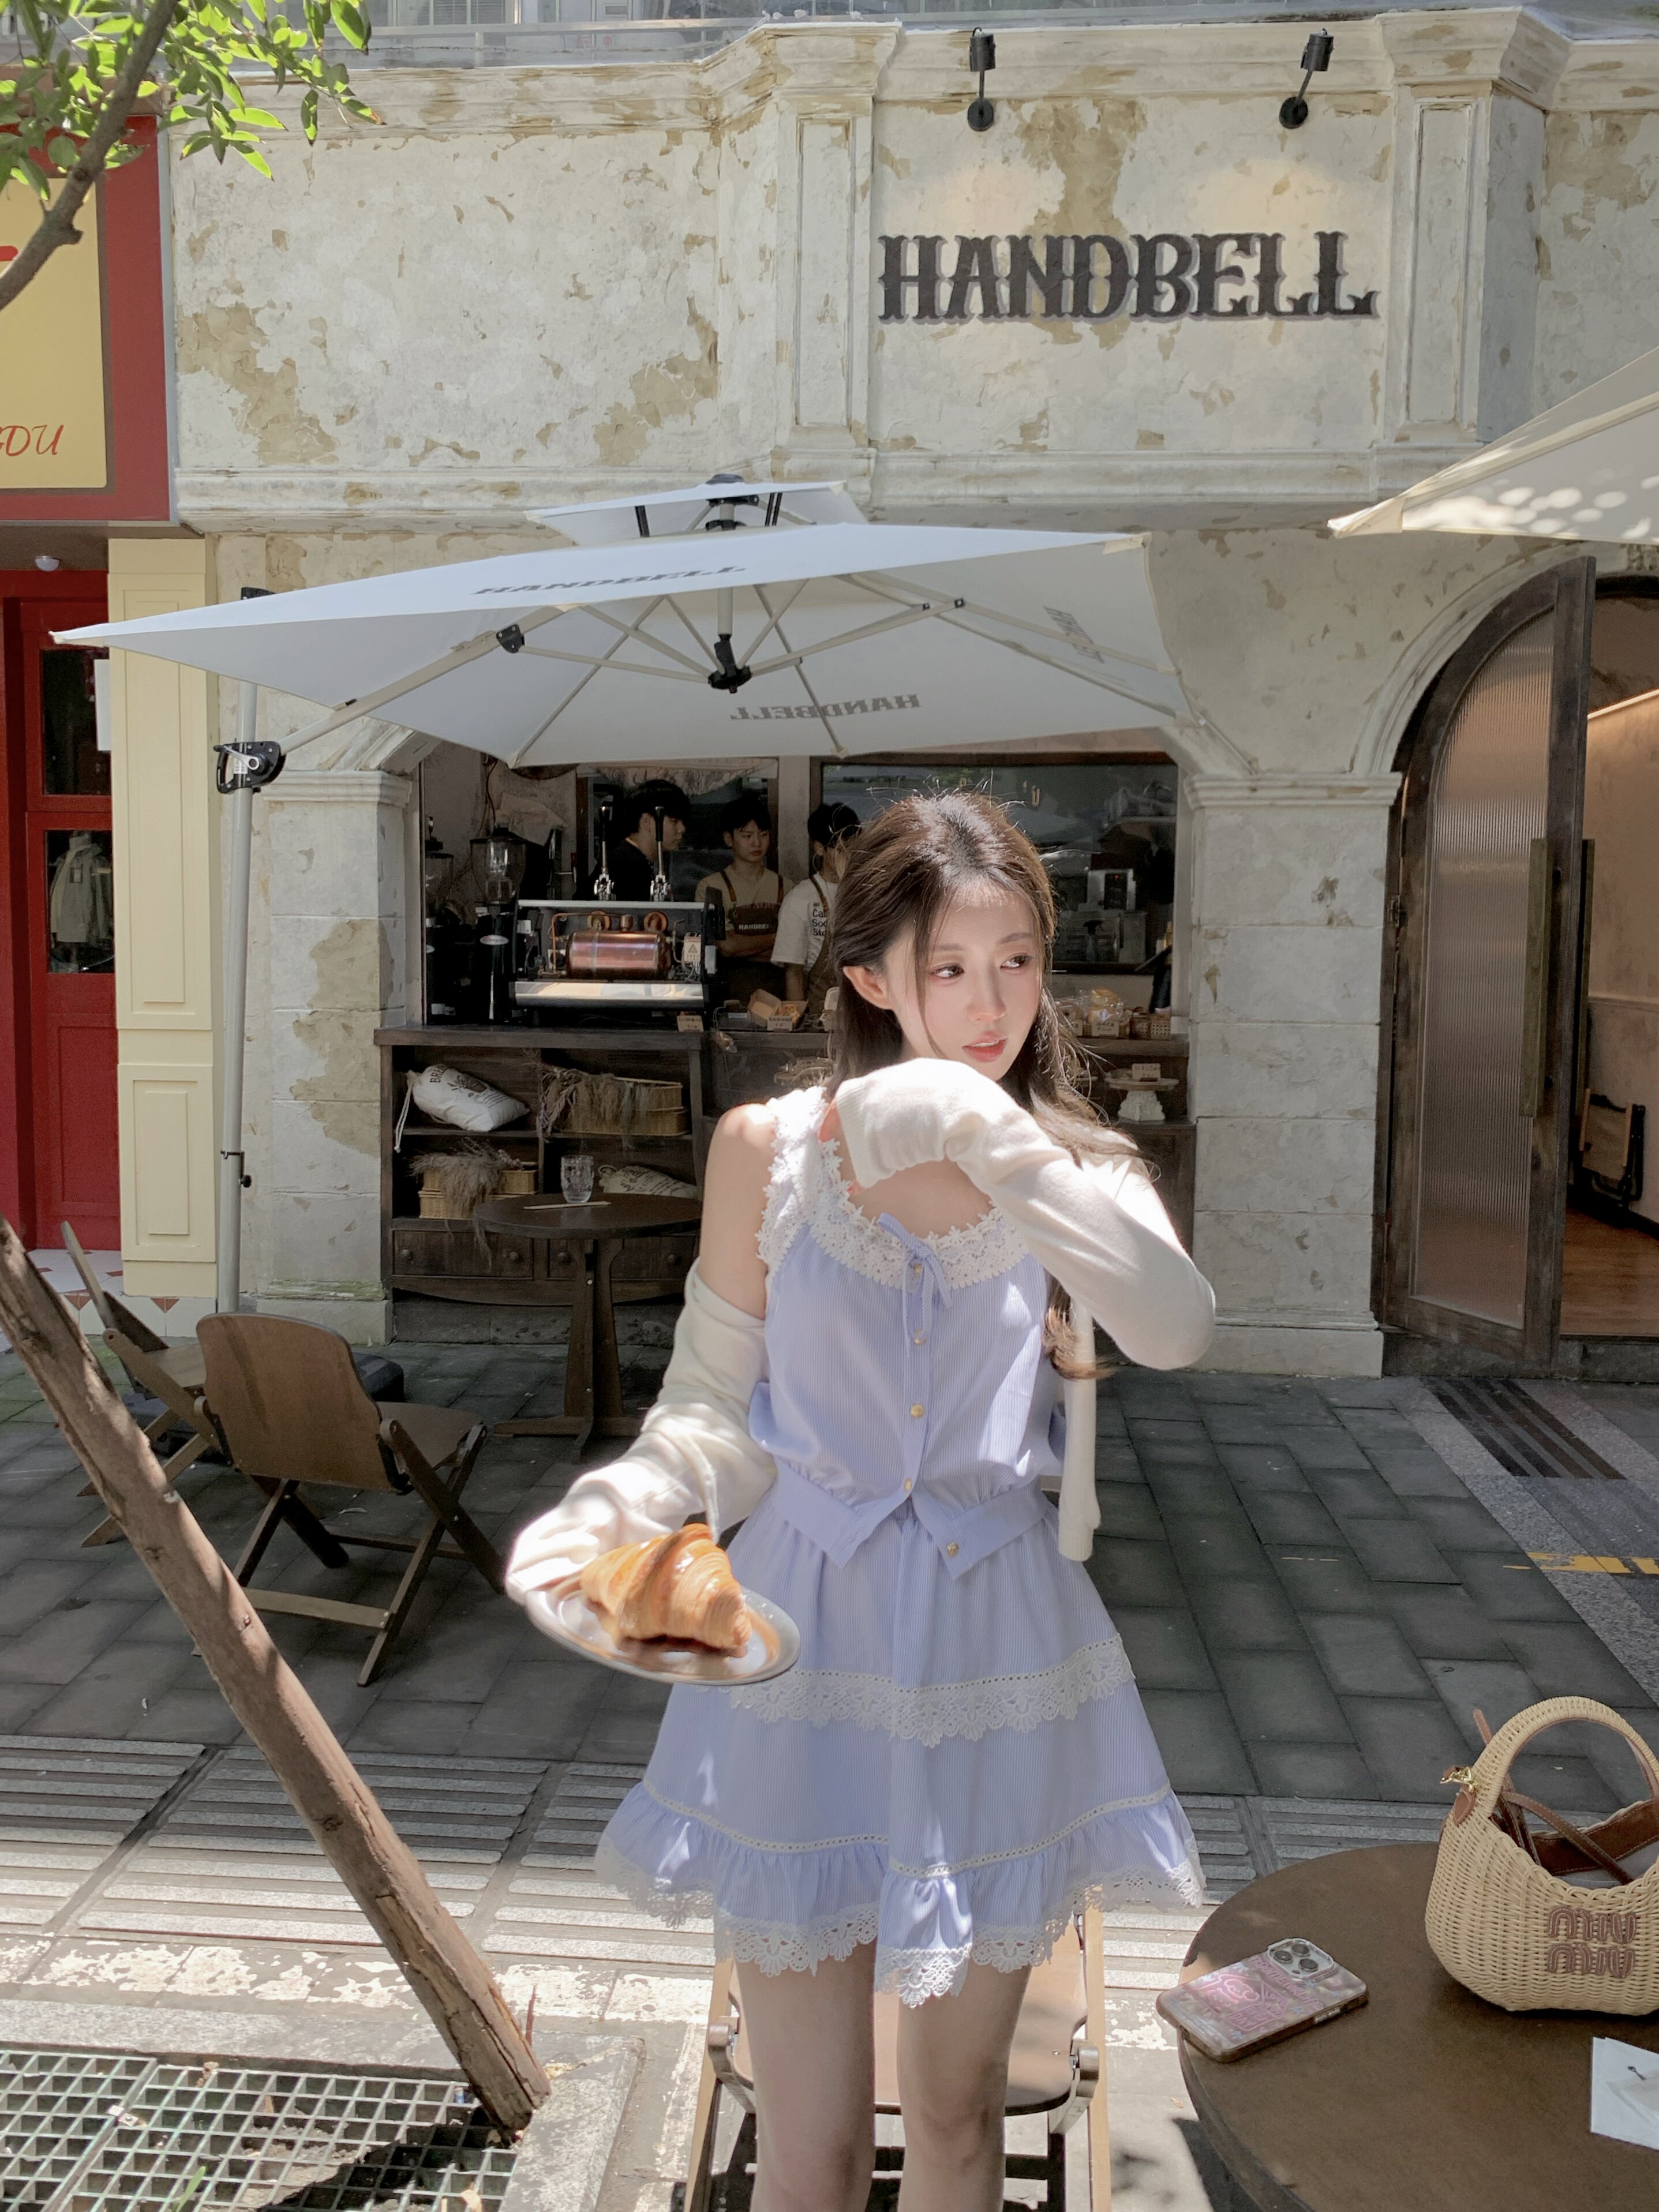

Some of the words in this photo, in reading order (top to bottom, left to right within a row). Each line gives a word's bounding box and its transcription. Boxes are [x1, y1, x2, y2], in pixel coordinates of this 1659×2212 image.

[876, 230, 1379, 321] HANDBELL
[0, 425, 64, 456] DU
[470, 565, 747, 595] HANDBELL
